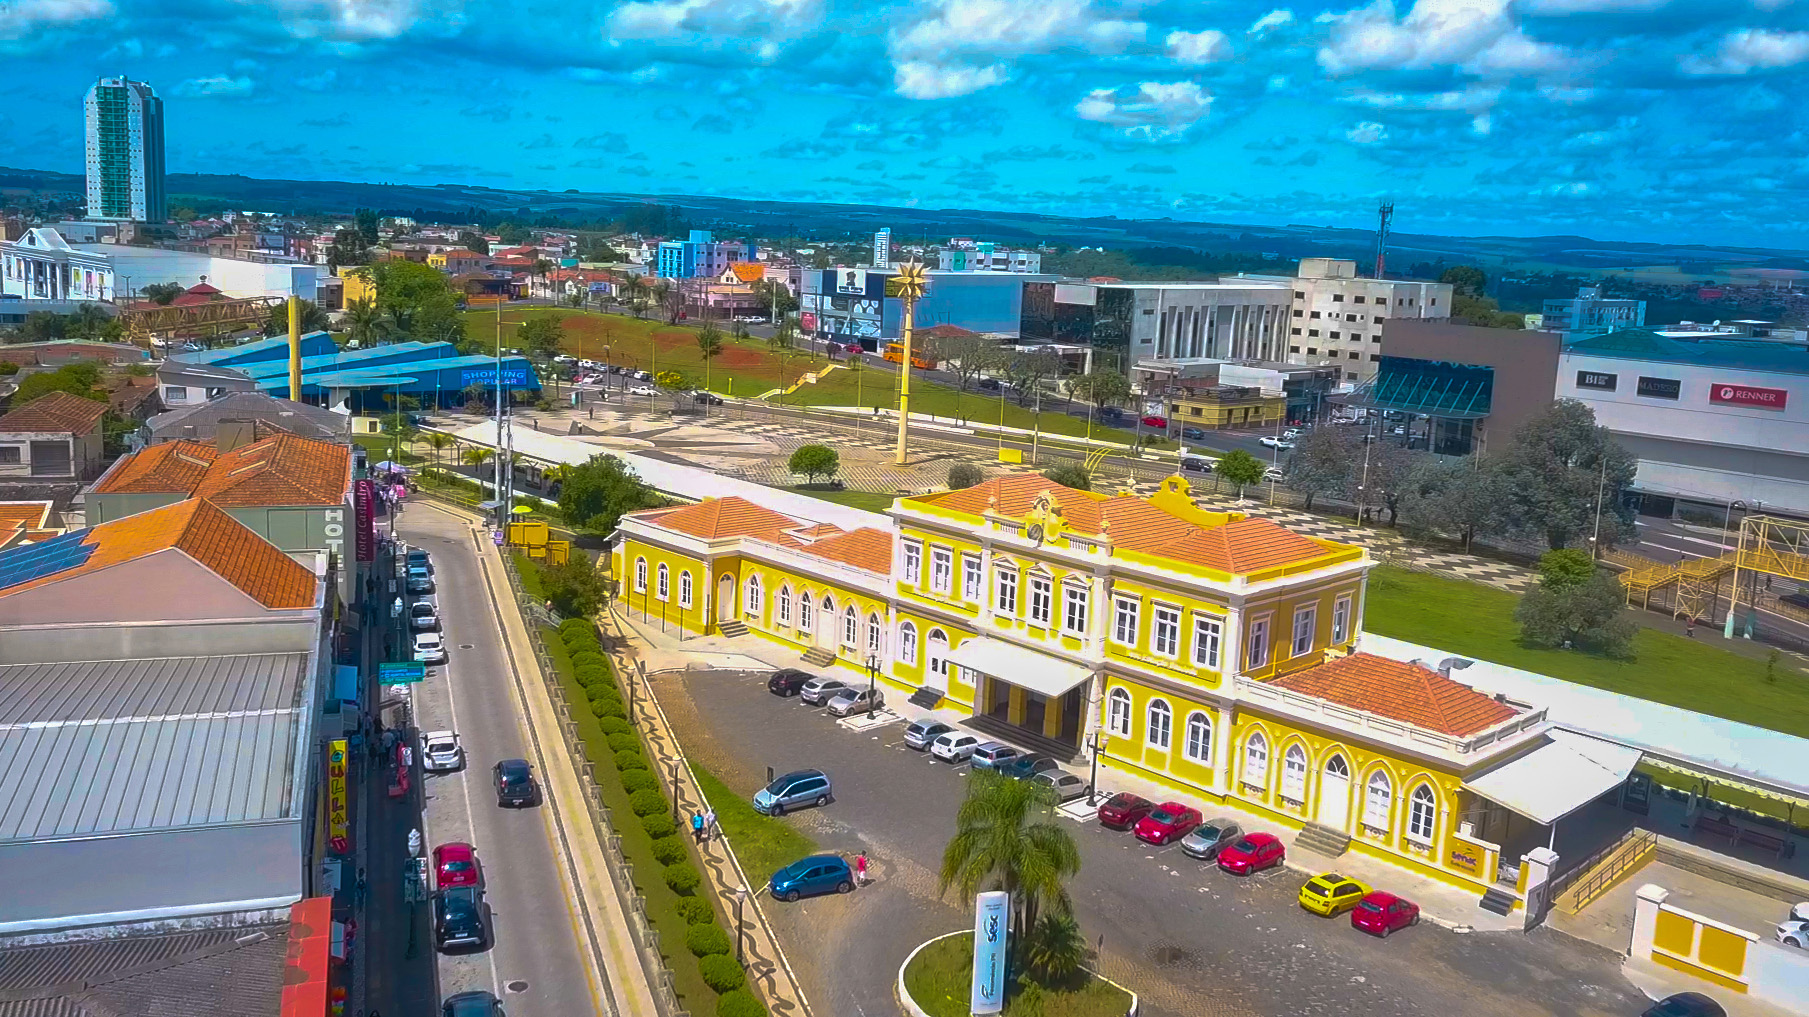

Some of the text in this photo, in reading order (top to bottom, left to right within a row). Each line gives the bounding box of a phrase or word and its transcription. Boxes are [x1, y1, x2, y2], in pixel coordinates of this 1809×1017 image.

[463, 371, 524, 380] SHOPING
[1736, 390, 1776, 402] RENNER
[324, 509, 344, 583] HOT
[357, 481, 368, 560] Hotel Casimiro
[331, 750, 345, 824] GULLA
